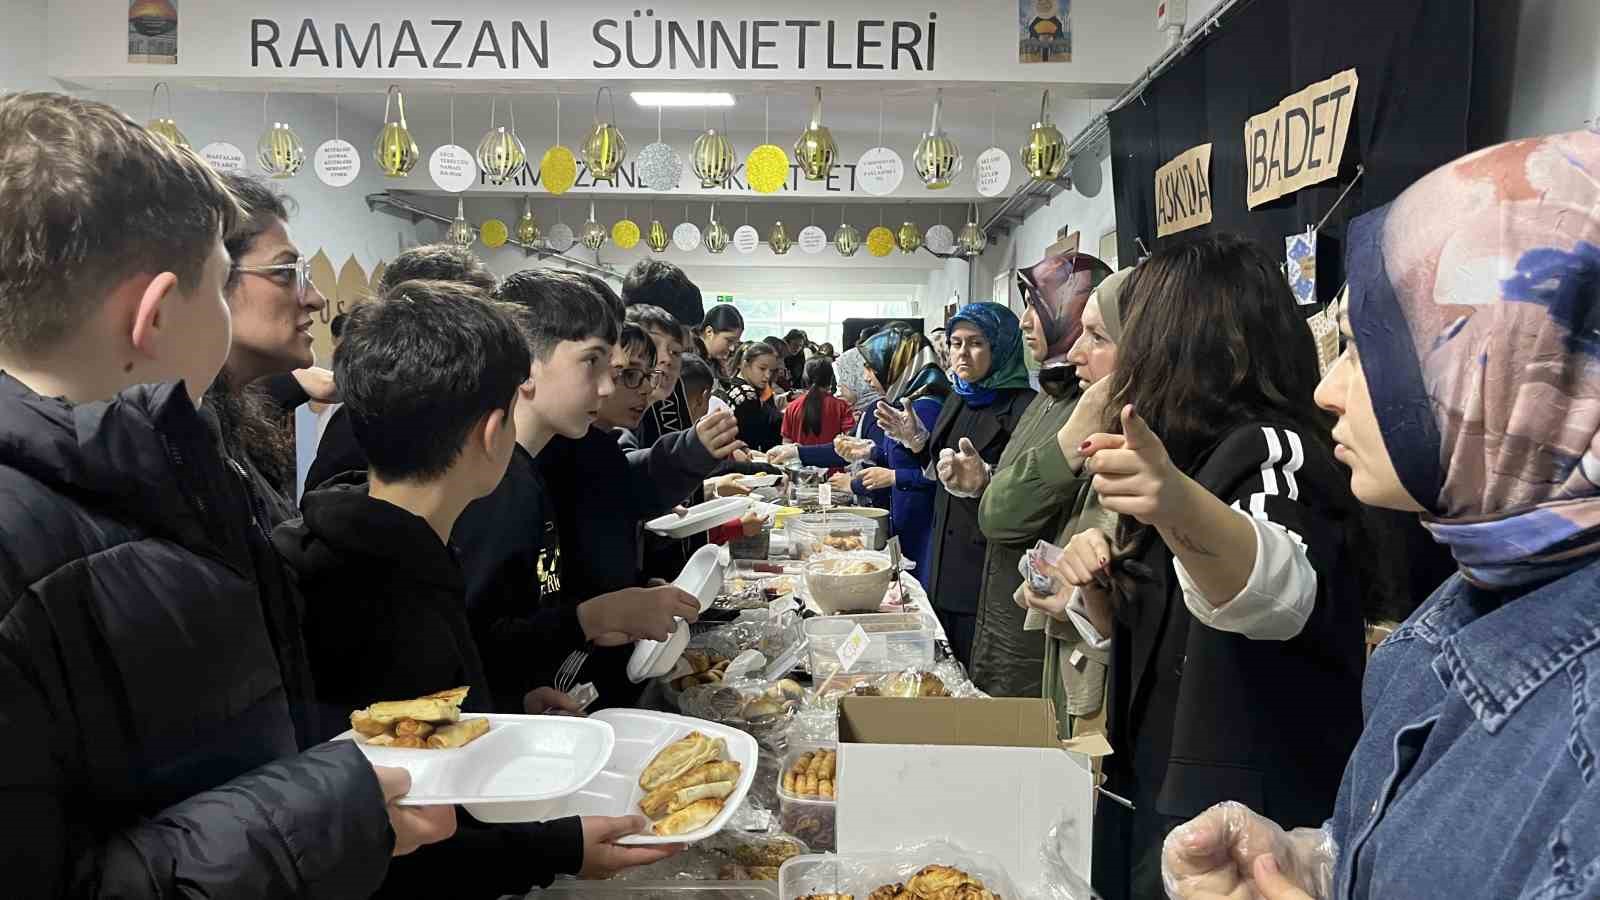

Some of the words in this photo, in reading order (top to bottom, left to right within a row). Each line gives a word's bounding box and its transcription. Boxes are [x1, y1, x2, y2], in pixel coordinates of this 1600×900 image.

[251, 18, 549, 69] RAMAZAN
[592, 9, 936, 71] SÜNNETLERİ
[1158, 158, 1210, 227] ASKIDA
